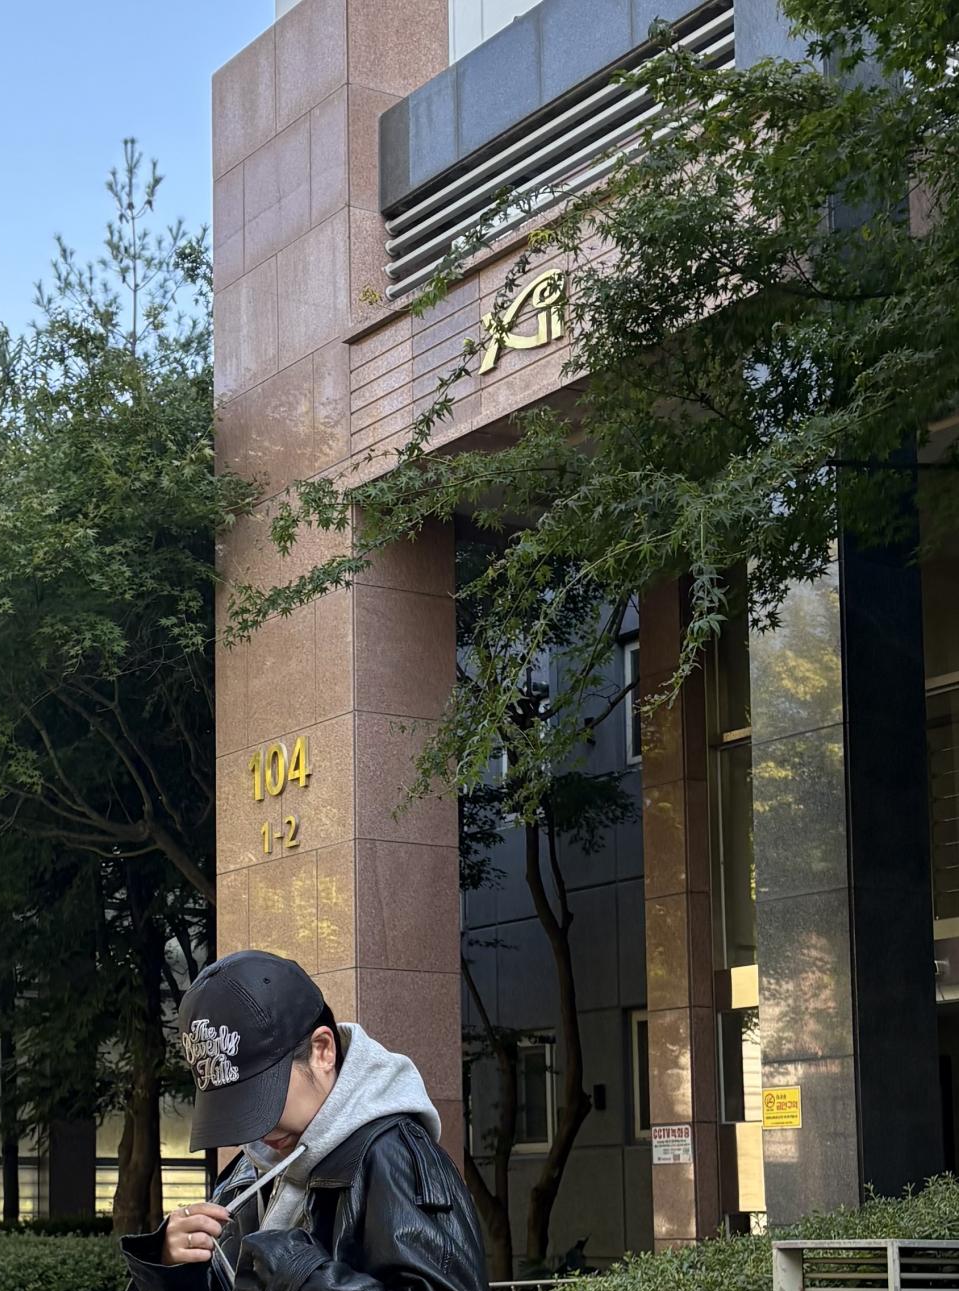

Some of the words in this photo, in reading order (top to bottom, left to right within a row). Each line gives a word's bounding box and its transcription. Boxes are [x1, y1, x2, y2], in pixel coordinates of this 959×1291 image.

[248, 735, 312, 802] 104
[260, 815, 300, 855] 1-2
[182, 1025, 240, 1065] Beverly
[189, 1019, 217, 1043] The
[196, 1054, 239, 1091] Hills
